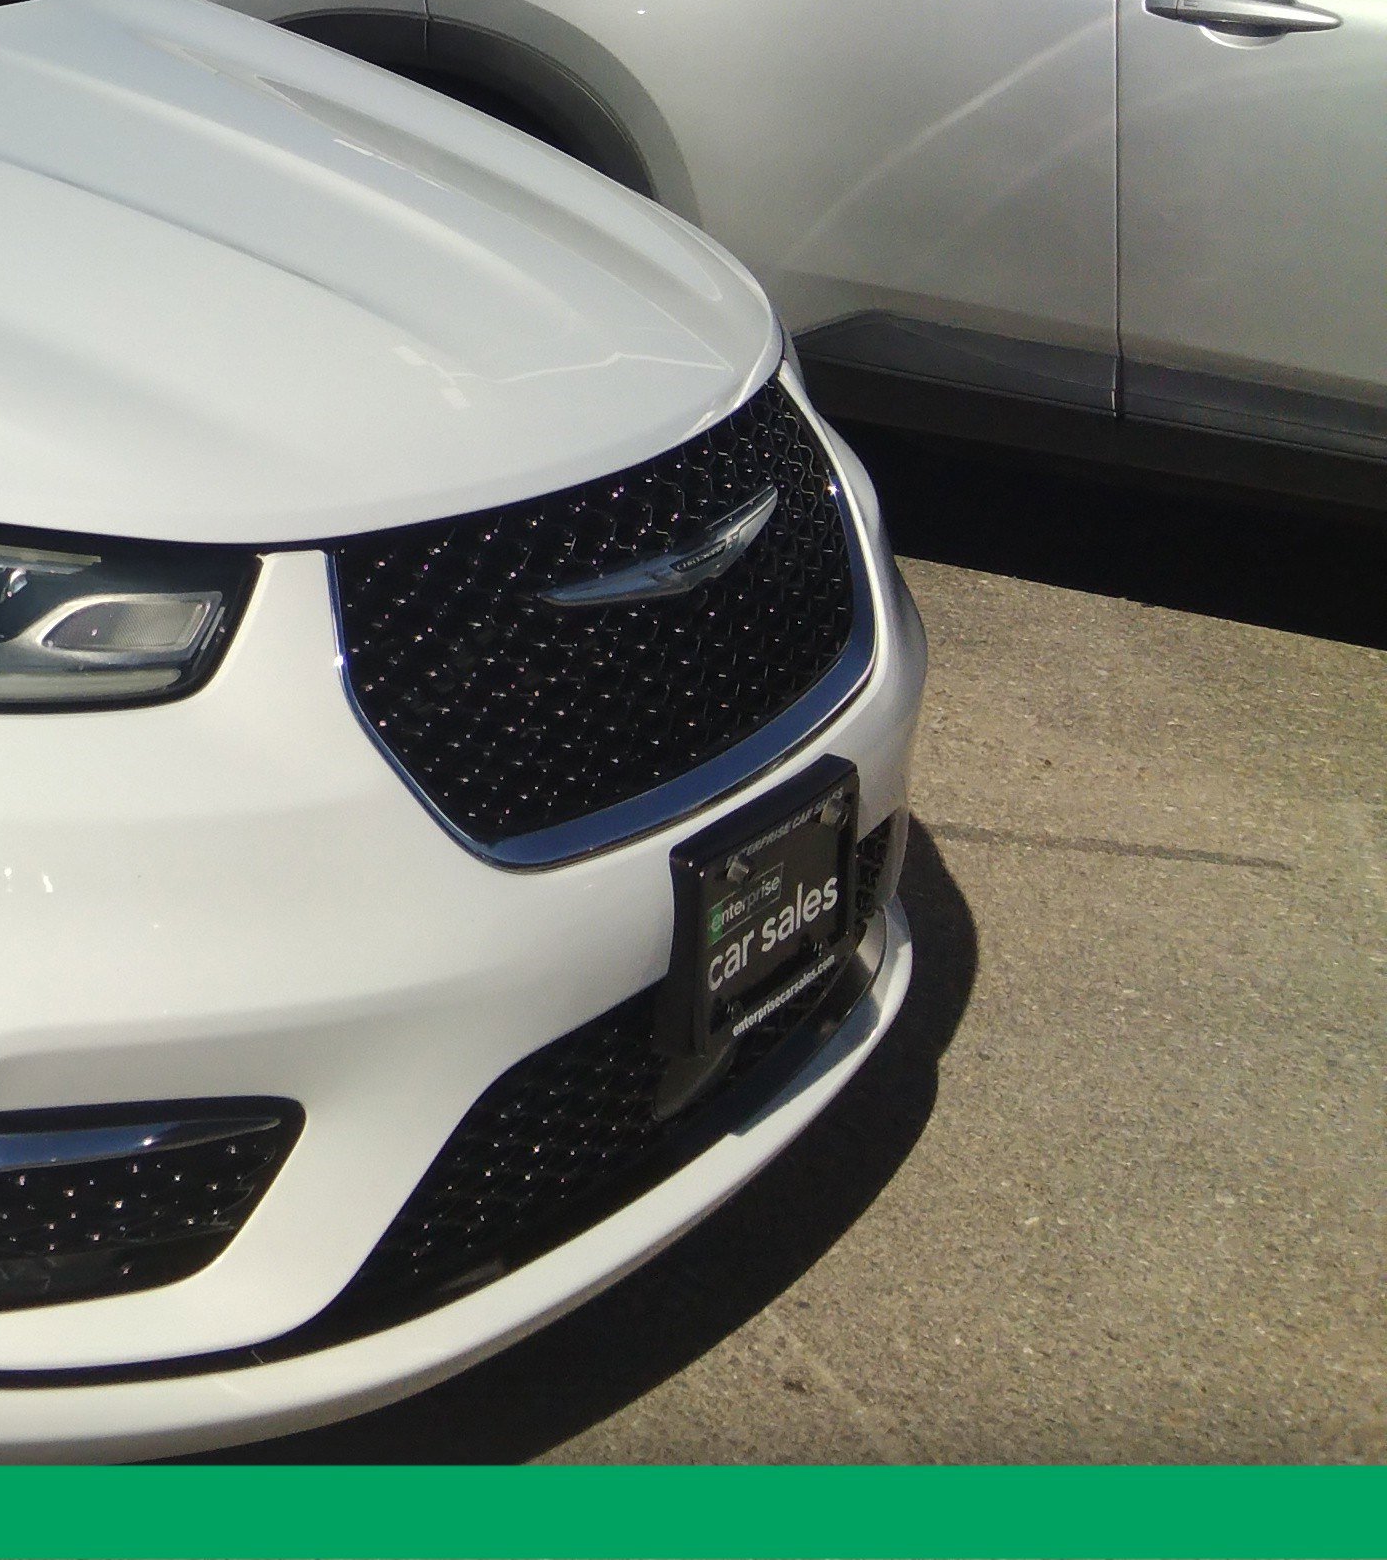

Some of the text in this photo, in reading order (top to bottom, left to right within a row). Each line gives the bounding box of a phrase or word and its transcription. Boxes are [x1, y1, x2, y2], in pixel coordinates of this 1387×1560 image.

[708, 877, 838, 991] car sales
[711, 876, 780, 933] enterprise
[732, 954, 835, 1037] enterprisecarsales.com
